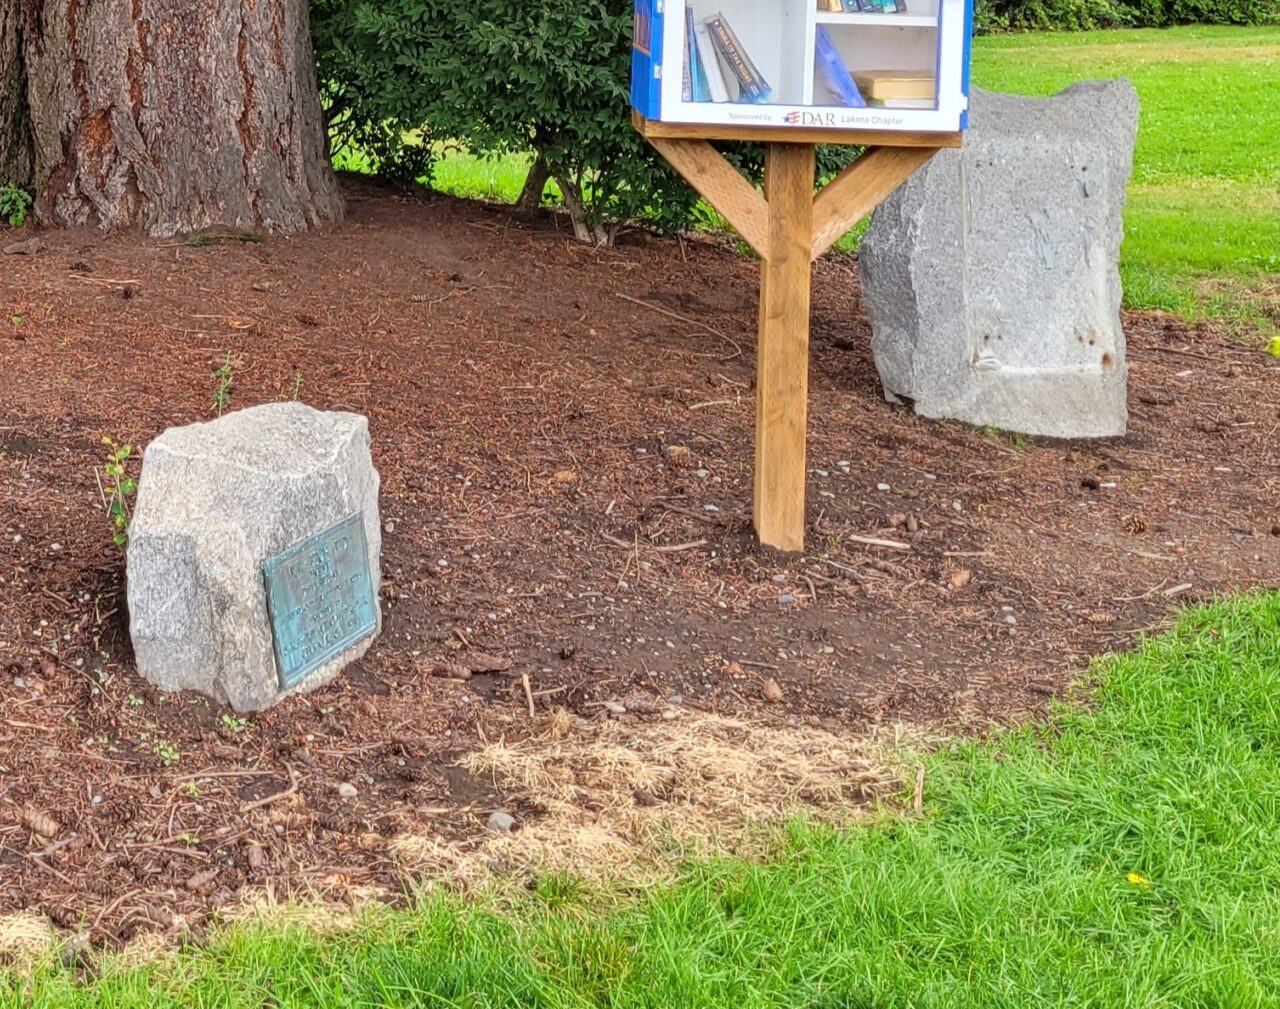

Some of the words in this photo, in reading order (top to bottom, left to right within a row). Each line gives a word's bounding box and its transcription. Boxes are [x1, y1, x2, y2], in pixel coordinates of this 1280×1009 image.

[802, 112, 836, 125] DAR
[841, 116, 869, 124] Lakota
[872, 117, 903, 126] Chapter
